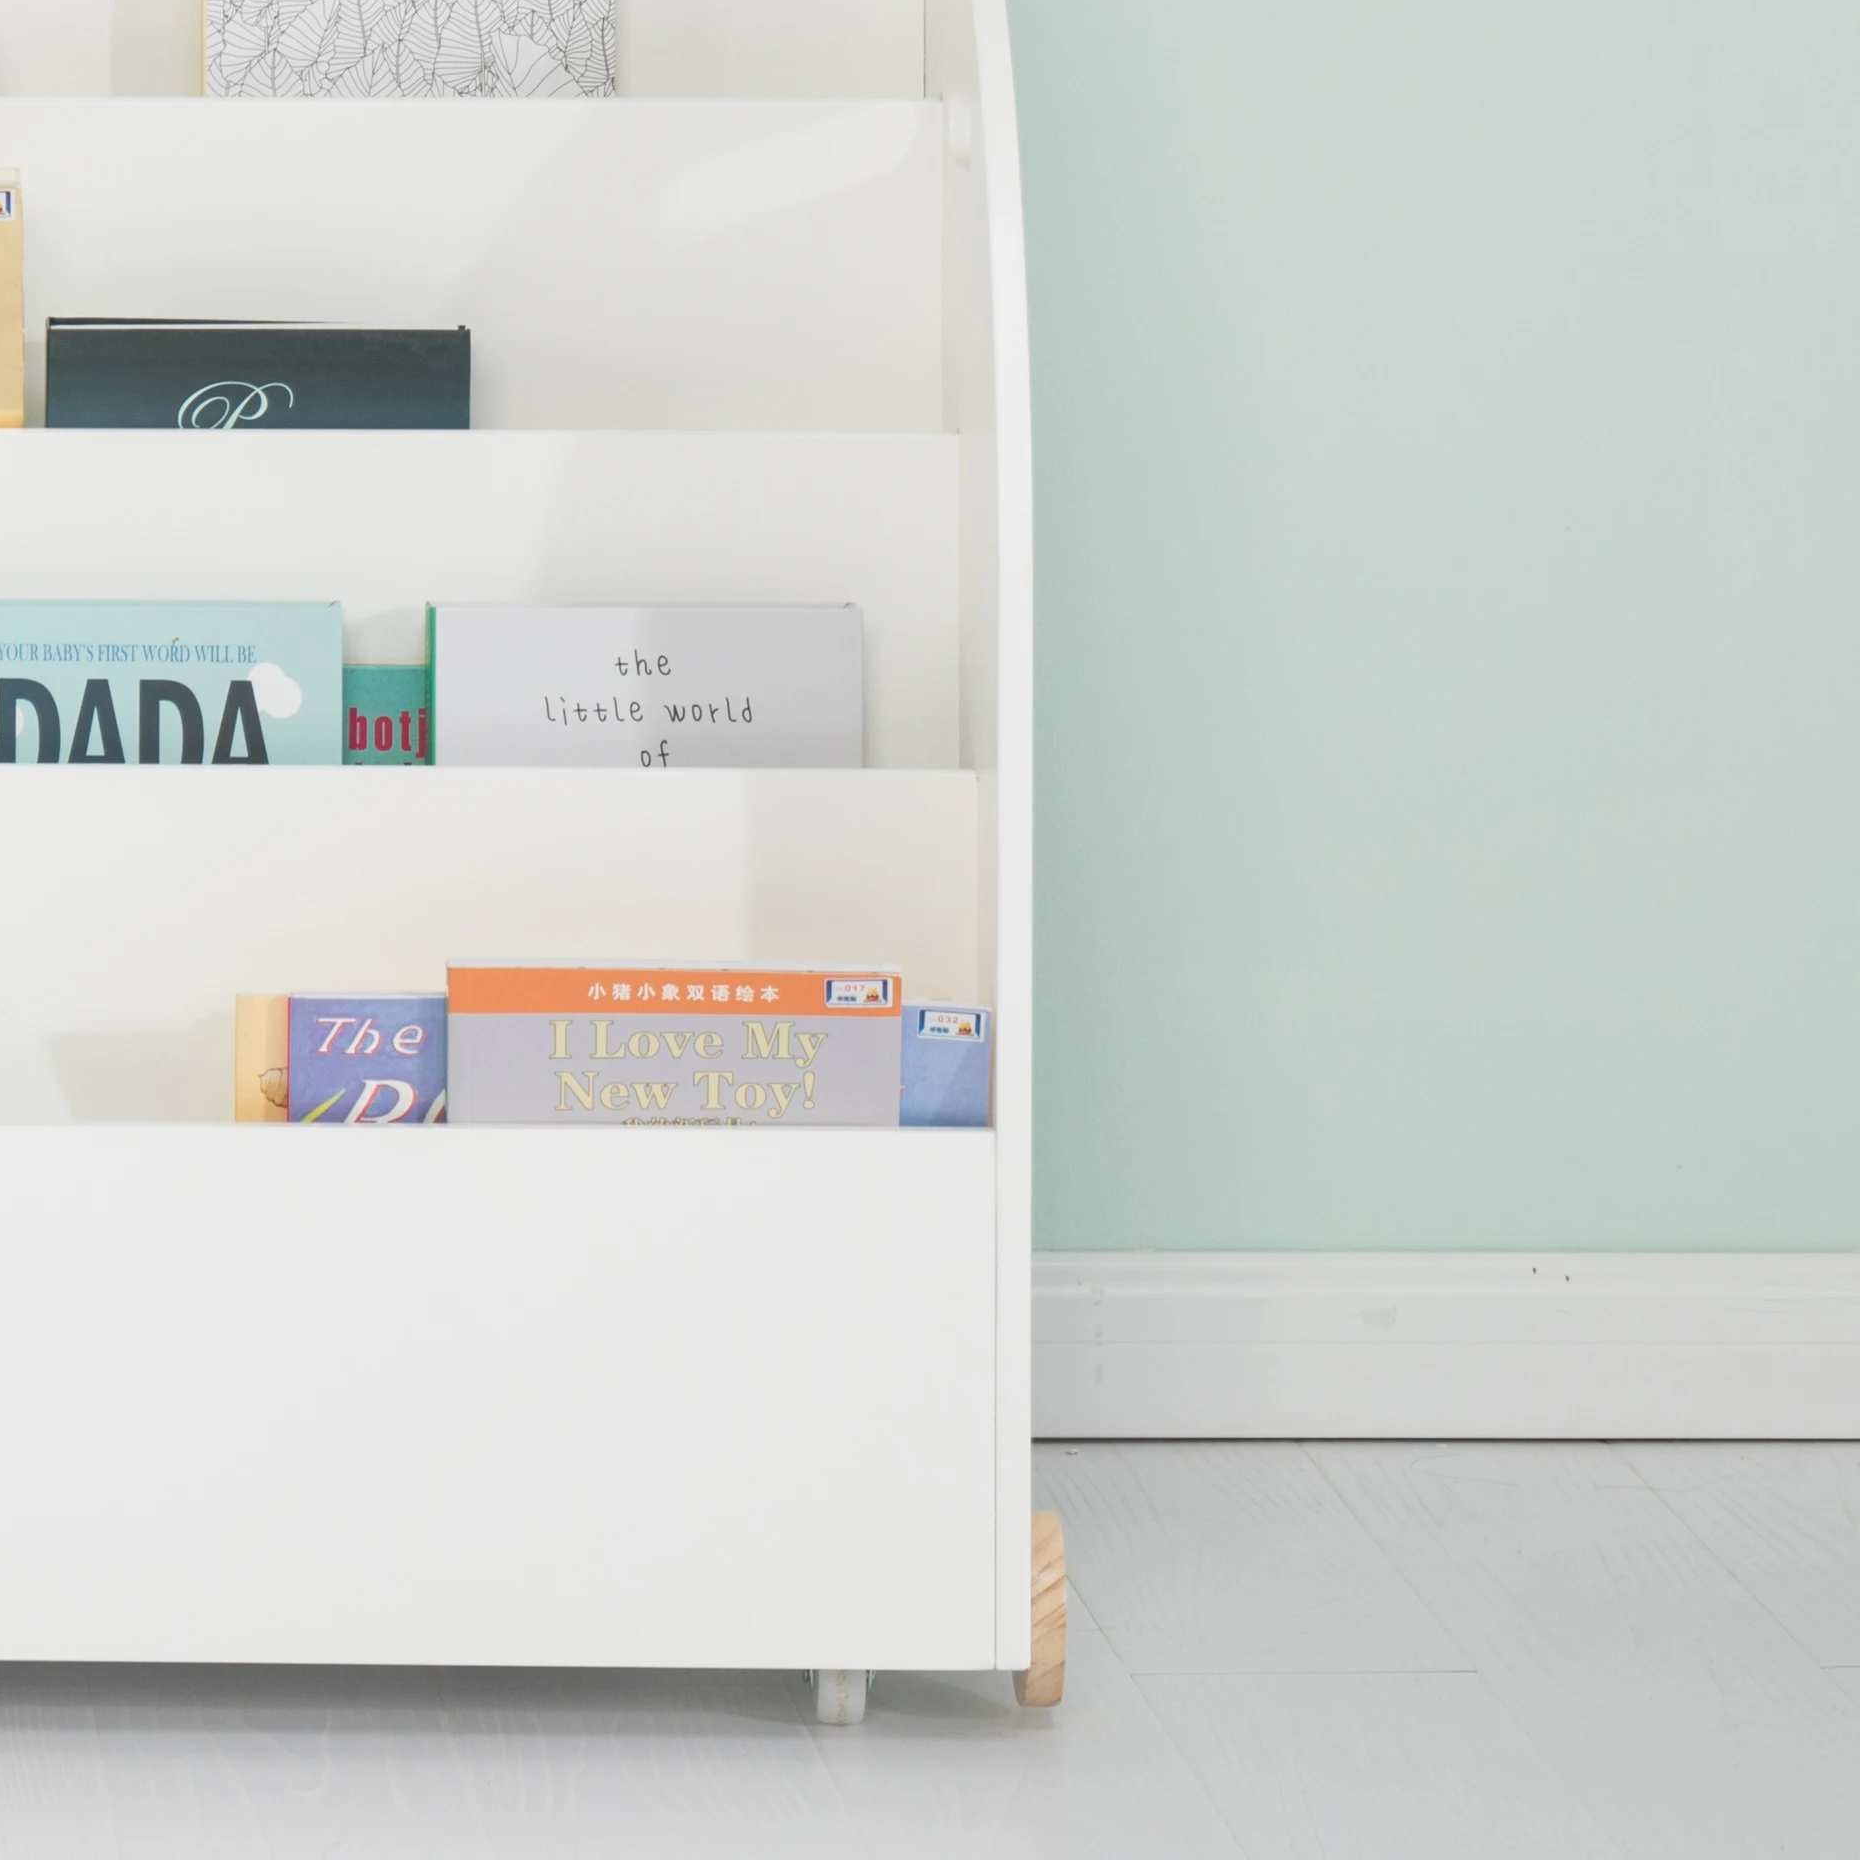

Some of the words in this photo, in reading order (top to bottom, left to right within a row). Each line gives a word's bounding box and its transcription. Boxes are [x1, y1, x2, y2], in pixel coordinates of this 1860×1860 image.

[43, 643, 94, 662] BABY'S
[97, 644, 139, 663] FIRST
[142, 644, 191, 664] WORD
[195, 645, 234, 664] WILL
[237, 645, 258, 664] BE
[614, 649, 671, 676] the
[545, 696, 644, 726] little
[664, 696, 753, 724] world
[640, 739, 670, 767] of
[587, 982, 781, 1003] 小猪小象双语绘本
[316, 1017, 425, 1056] The
[549, 1019, 573, 1060] I
[589, 1019, 725, 1060] Love
[741, 1021, 829, 1068] My
[553, 1071, 679, 1111] New
[693, 1070, 816, 1118] Toy!
